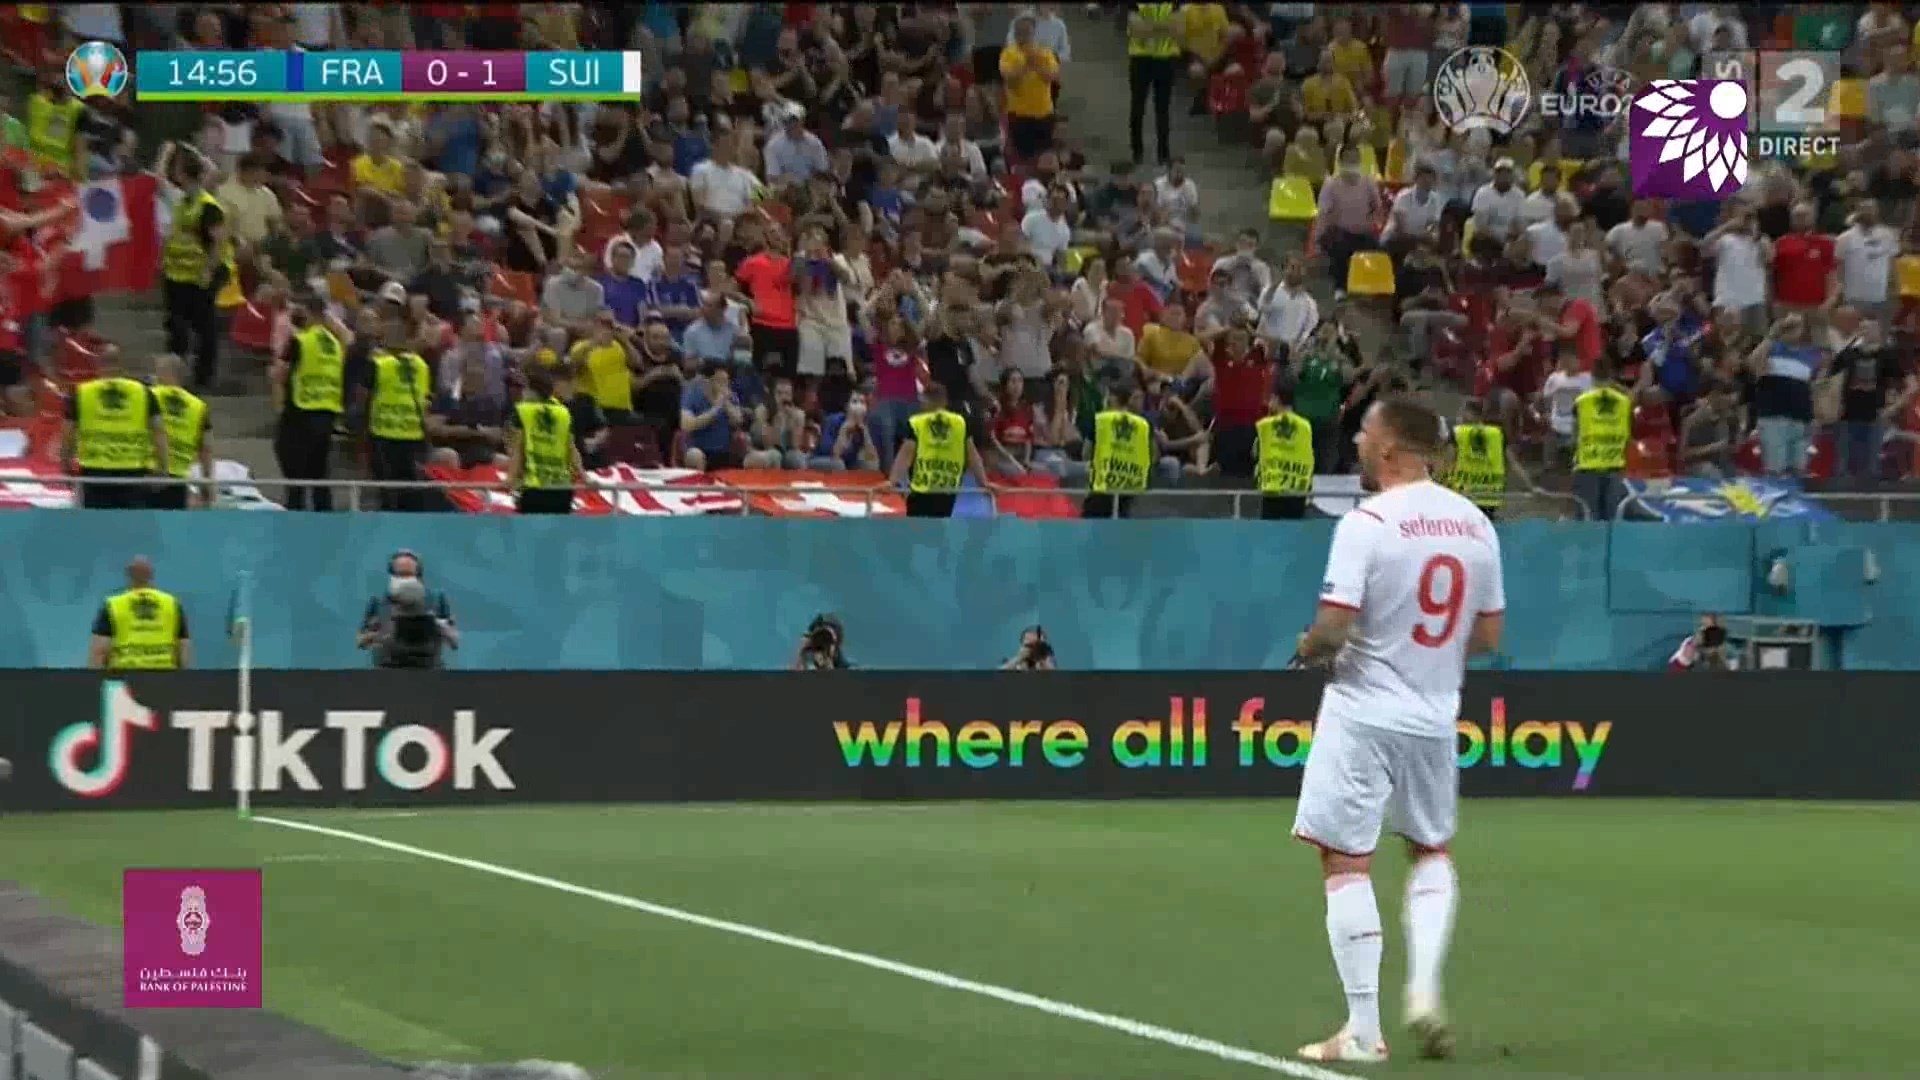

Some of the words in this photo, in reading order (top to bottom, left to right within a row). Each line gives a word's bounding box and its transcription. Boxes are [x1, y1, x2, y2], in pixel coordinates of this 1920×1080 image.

[1411, 553, 1466, 649] 9
[170, 709, 516, 792] TikTok
[832, 697, 1088, 769] where
[1111, 696, 1208, 769] all
[1231, 697, 1312, 769] fa
